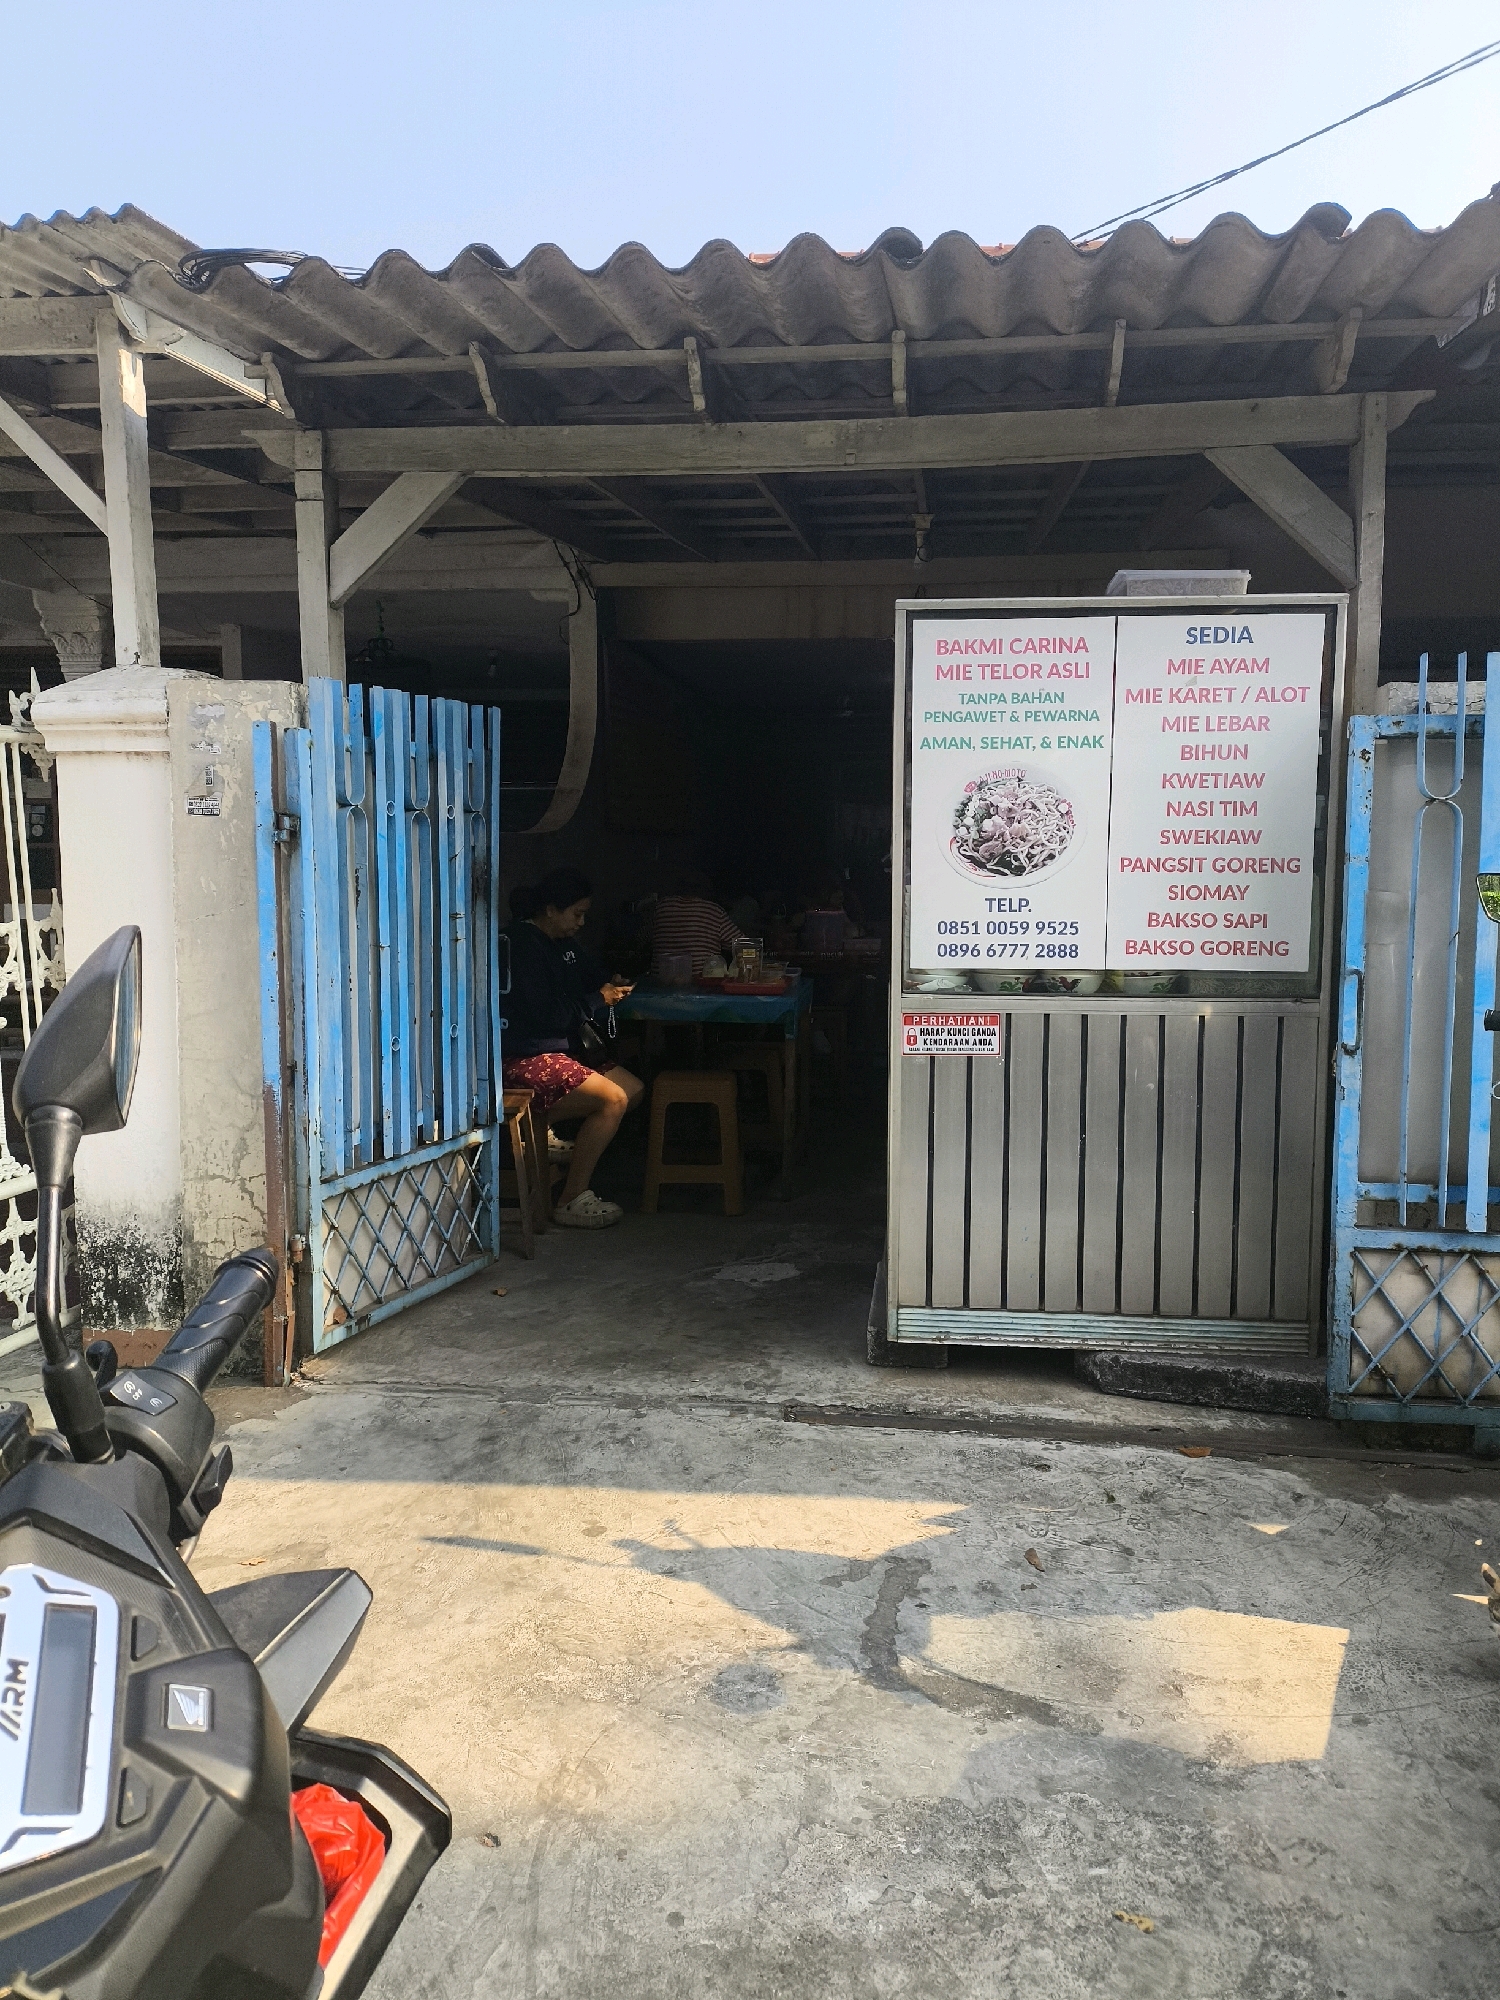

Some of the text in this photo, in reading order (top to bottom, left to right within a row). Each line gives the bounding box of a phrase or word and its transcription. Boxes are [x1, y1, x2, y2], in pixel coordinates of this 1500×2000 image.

[1186, 626, 1254, 644] SEDIA
[937, 637, 1089, 655] BAKMI CARINA
[937, 662, 1089, 680] MIE TELOR ASLI
[1168, 658, 1270, 675] MIE AYAM
[958, 692, 1064, 705] TANPA BAHAN
[1126, 686, 1310, 704] MIE KARET / ALOT
[925, 710, 1100, 722] PENGAWET & PEWARNA
[1162, 716, 1270, 732] MIE LEBAR
[920, 735, 1104, 751] AMAN, SEHAT, & ENAK
[1181, 744, 1248, 760] BIHUN
[1162, 773, 1265, 789] KWETIAW
[1167, 801, 1257, 816] NASI TIM
[1160, 830, 1262, 844] SWEKIAW
[1121, 857, 1300, 873] PANGSIT GORENG
[1169, 885, 1250, 900] SIOMAY
[985, 898, 1031, 912] TELP.
[938, 921, 1078, 935] 0851 0059 9525
[1148, 912, 1267, 928] BAKSO SAPI
[938, 944, 1078, 958] 0896 6777 2888
[1126, 940, 1289, 956] BAKSO GORENG
[913, 1016, 991, 1026] PERHATIAN!
[920, 1027, 997, 1037] HARAP KUNCI GANDA
[923, 1038, 993, 1047] KENDARAAN ANDA
